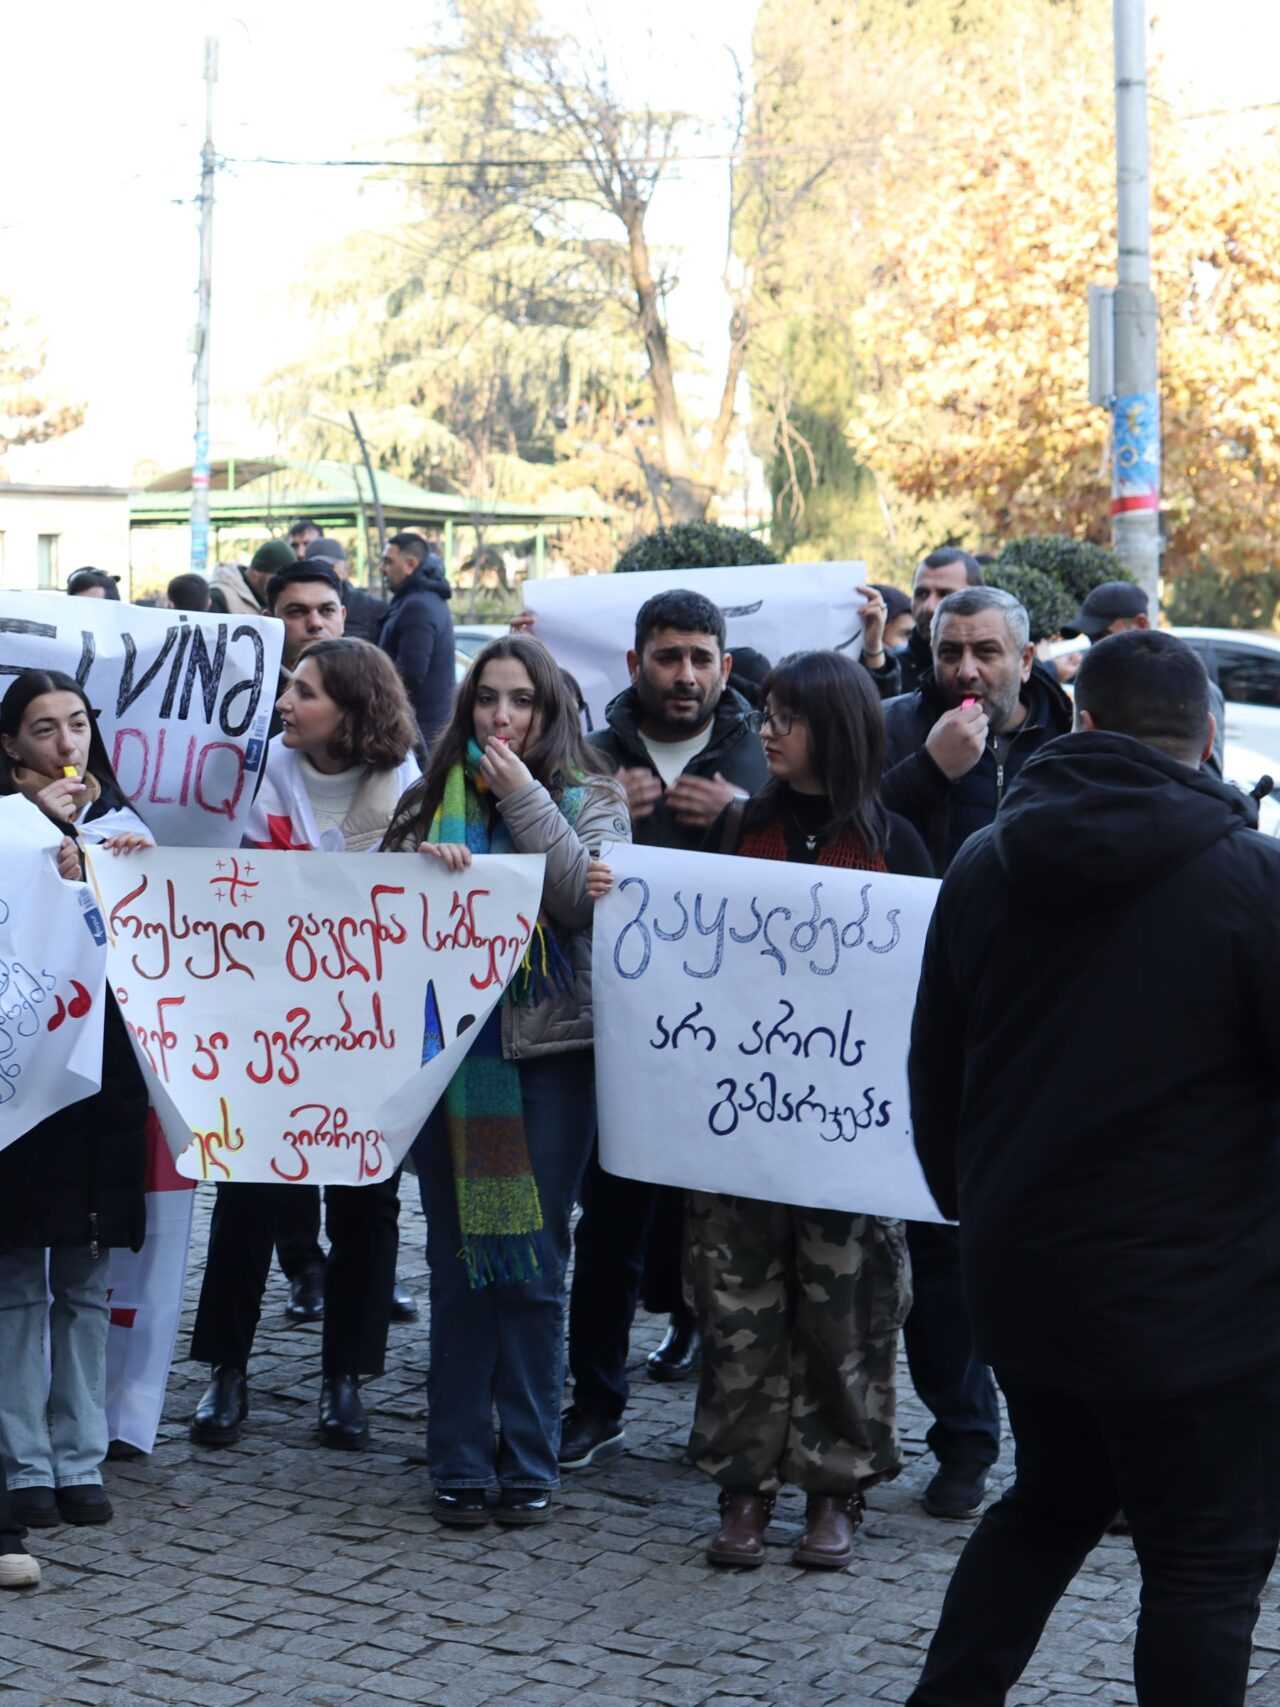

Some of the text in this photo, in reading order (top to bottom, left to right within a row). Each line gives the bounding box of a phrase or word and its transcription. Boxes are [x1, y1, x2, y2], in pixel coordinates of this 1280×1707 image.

[110, 874, 265, 981] რუსული
[285, 884, 408, 983] გავლენა
[613, 877, 900, 979] გაყალბება
[192, 1032, 229, 1081] კი
[246, 990, 395, 1085] ევროპის
[650, 999, 866, 1066] არ არის
[270, 1104, 385, 1181] ვირჩევ
